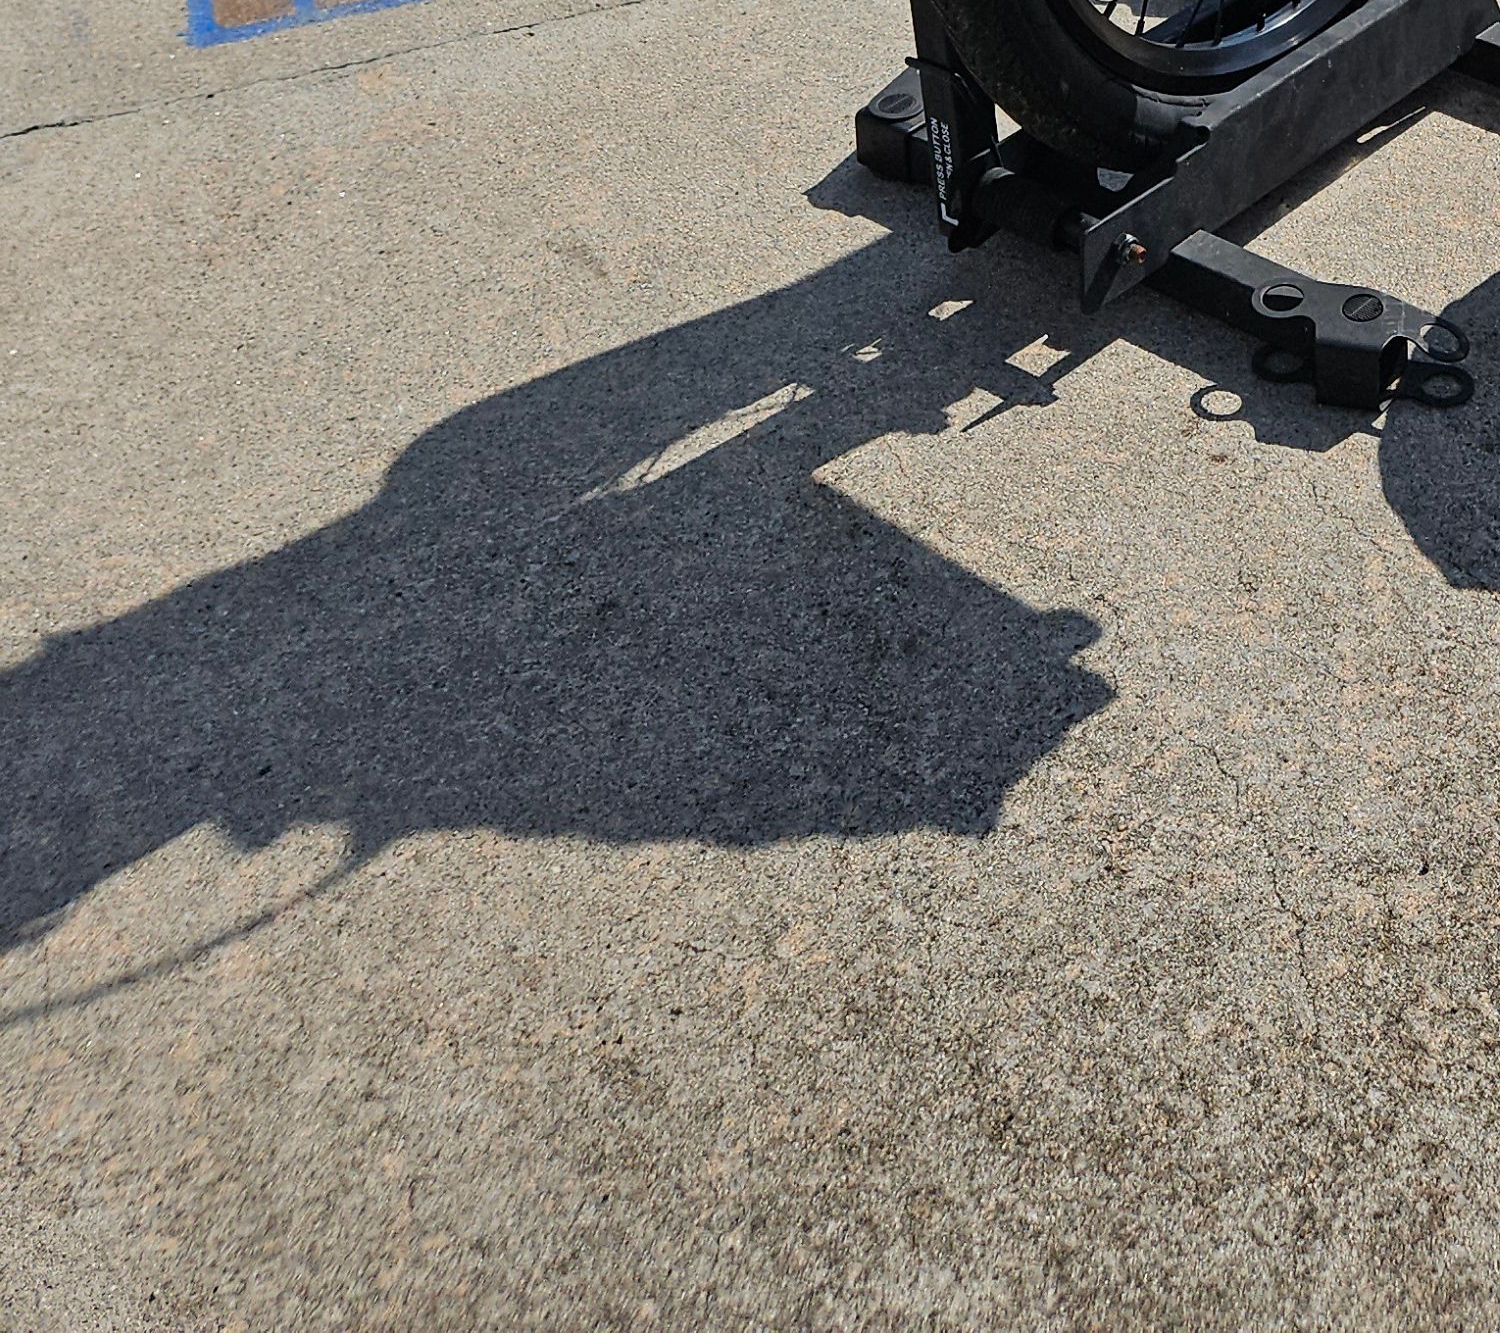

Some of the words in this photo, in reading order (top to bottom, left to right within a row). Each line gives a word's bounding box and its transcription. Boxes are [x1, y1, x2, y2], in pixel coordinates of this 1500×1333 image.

[930, 116, 942, 163] BUTTON
[940, 121, 952, 155] CLOSE
[936, 163, 947, 201] PRESS
